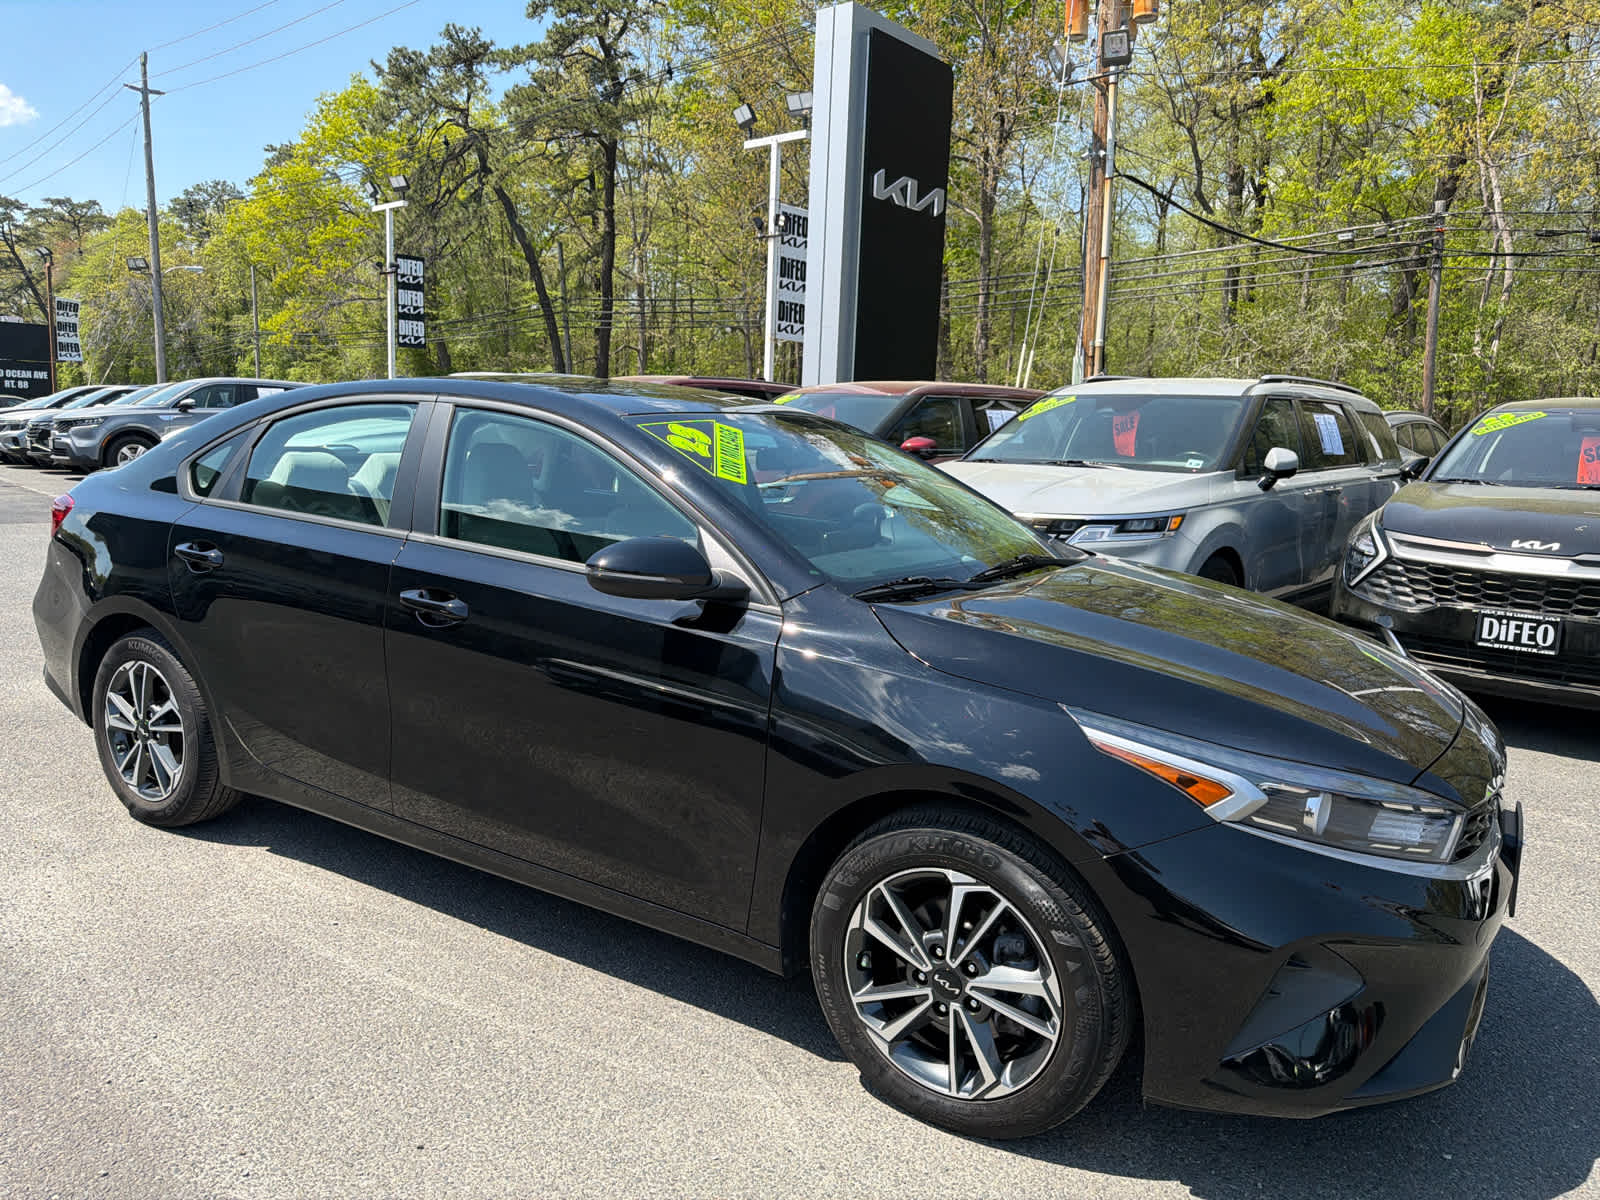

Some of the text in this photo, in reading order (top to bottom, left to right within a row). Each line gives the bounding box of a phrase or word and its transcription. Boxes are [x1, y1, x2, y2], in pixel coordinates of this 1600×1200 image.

[5, 369, 32, 379] OCEAN
[33, 370, 49, 380] AVE
[17, 380, 29, 389] 88
[1481, 617, 1554, 647] DiFEO
